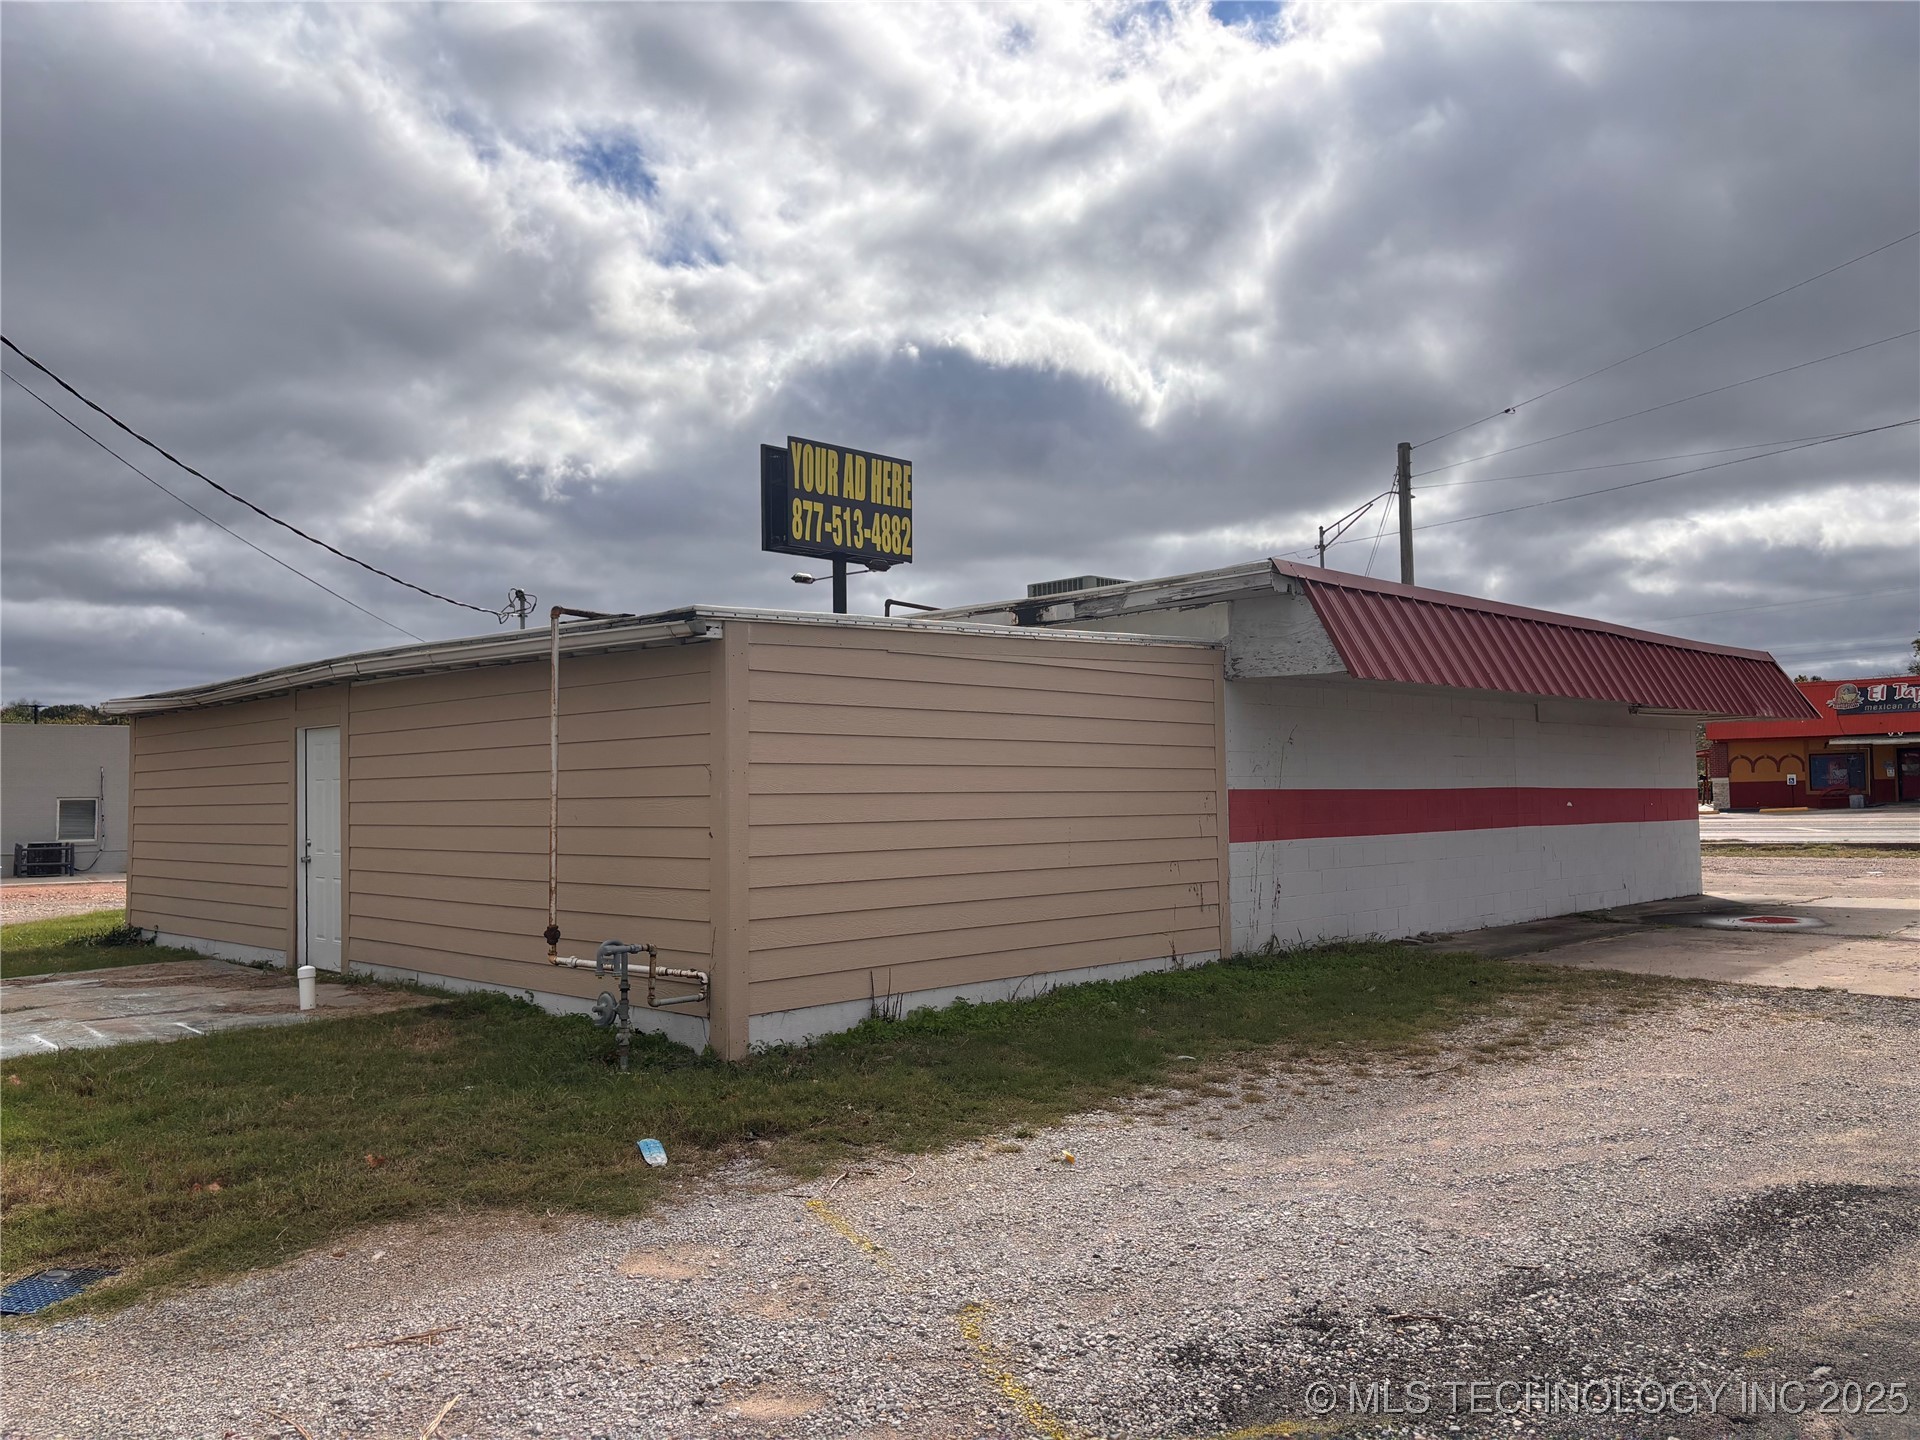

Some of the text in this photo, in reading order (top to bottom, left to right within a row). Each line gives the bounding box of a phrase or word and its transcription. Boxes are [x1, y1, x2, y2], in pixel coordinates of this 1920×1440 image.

[791, 441, 912, 510] YOUR AD HERE
[791, 497, 912, 556] 877-513-4882
[1865, 703, 1903, 711] mexican
[1867, 684, 1887, 701] El
